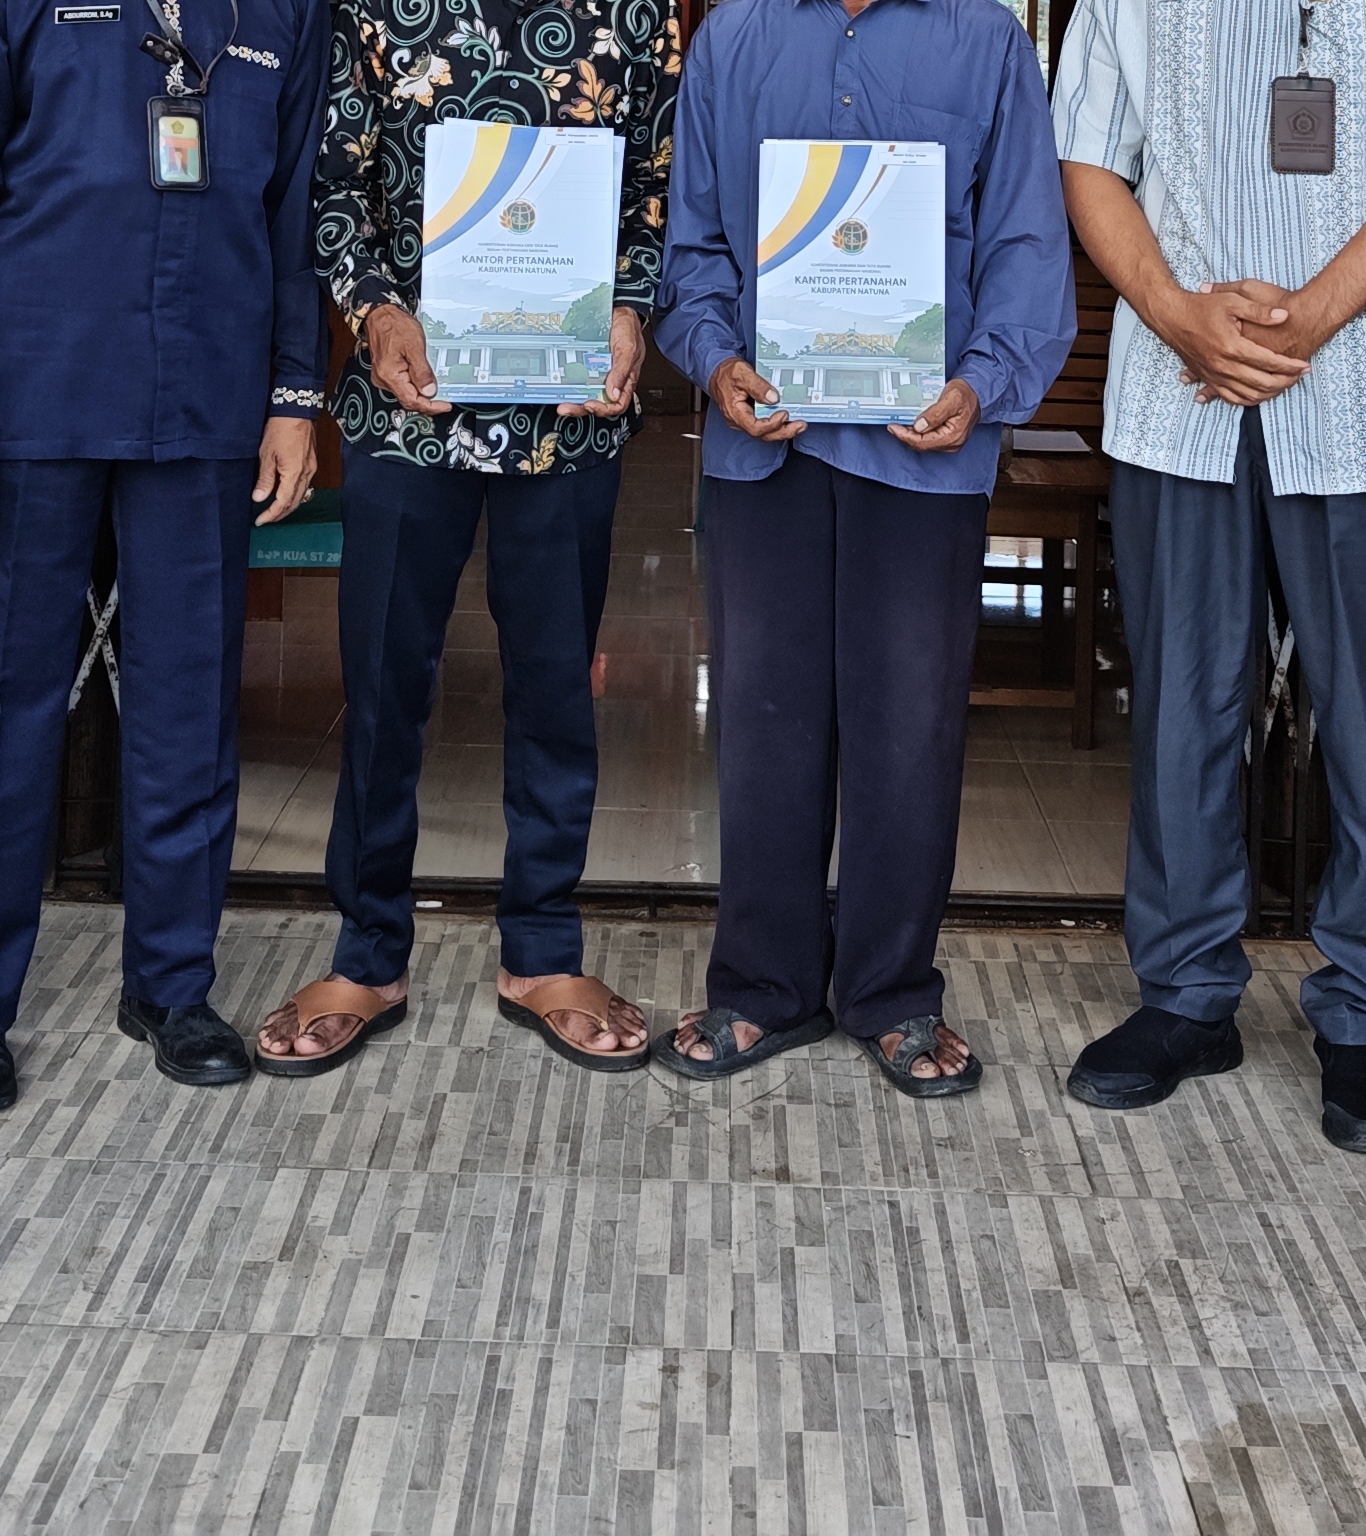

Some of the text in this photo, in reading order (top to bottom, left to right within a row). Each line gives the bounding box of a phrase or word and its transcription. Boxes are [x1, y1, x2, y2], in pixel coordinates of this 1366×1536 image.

[462, 255, 574, 265] KANTOR PERTANAHAN
[478, 266, 523, 274] KABUPATEN
[795, 276, 907, 286] KANTOR PERTANAHAN
[283, 551, 307, 561] KUA
[309, 552, 324, 562] ST
